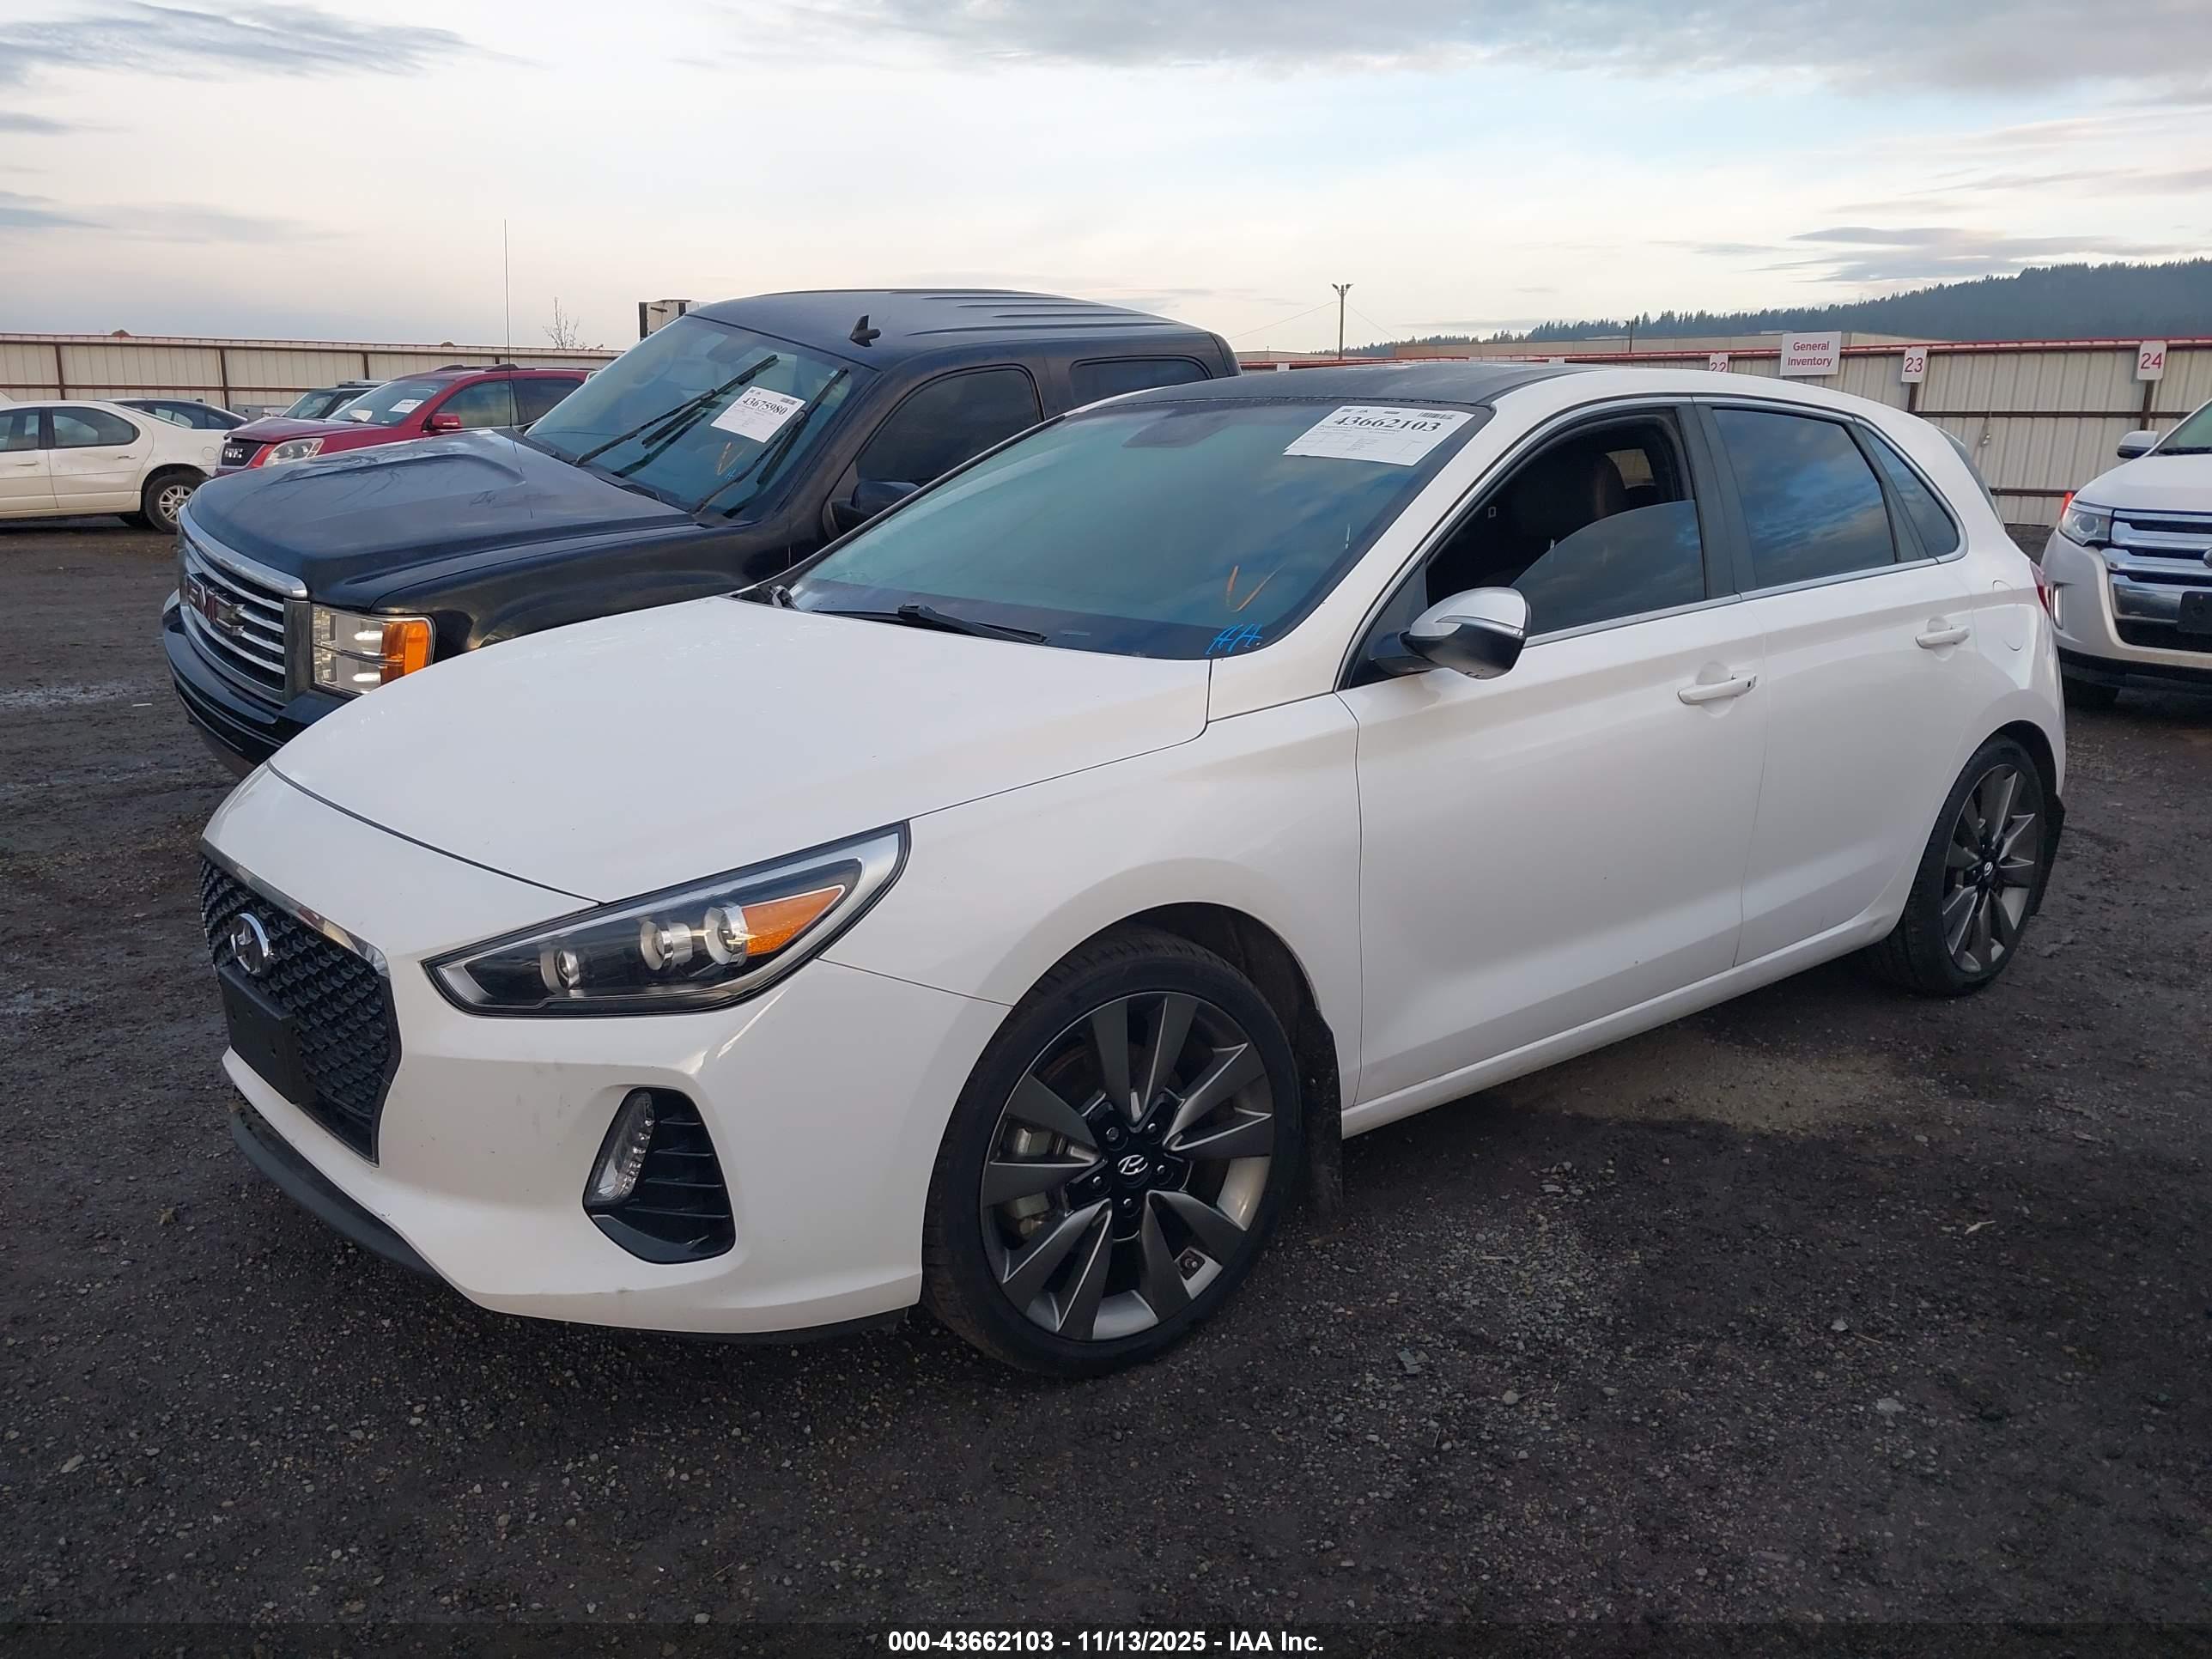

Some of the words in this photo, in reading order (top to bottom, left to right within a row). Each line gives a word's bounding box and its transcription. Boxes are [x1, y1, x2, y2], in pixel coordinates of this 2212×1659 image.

[1792, 341, 1830, 351] General
[1788, 356, 1833, 368] Inventory
[1904, 357, 1923, 373] 23
[2141, 352, 2162, 369] 24
[742, 397, 789, 416] 43675980
[1333, 416, 1443, 432] 43662103
